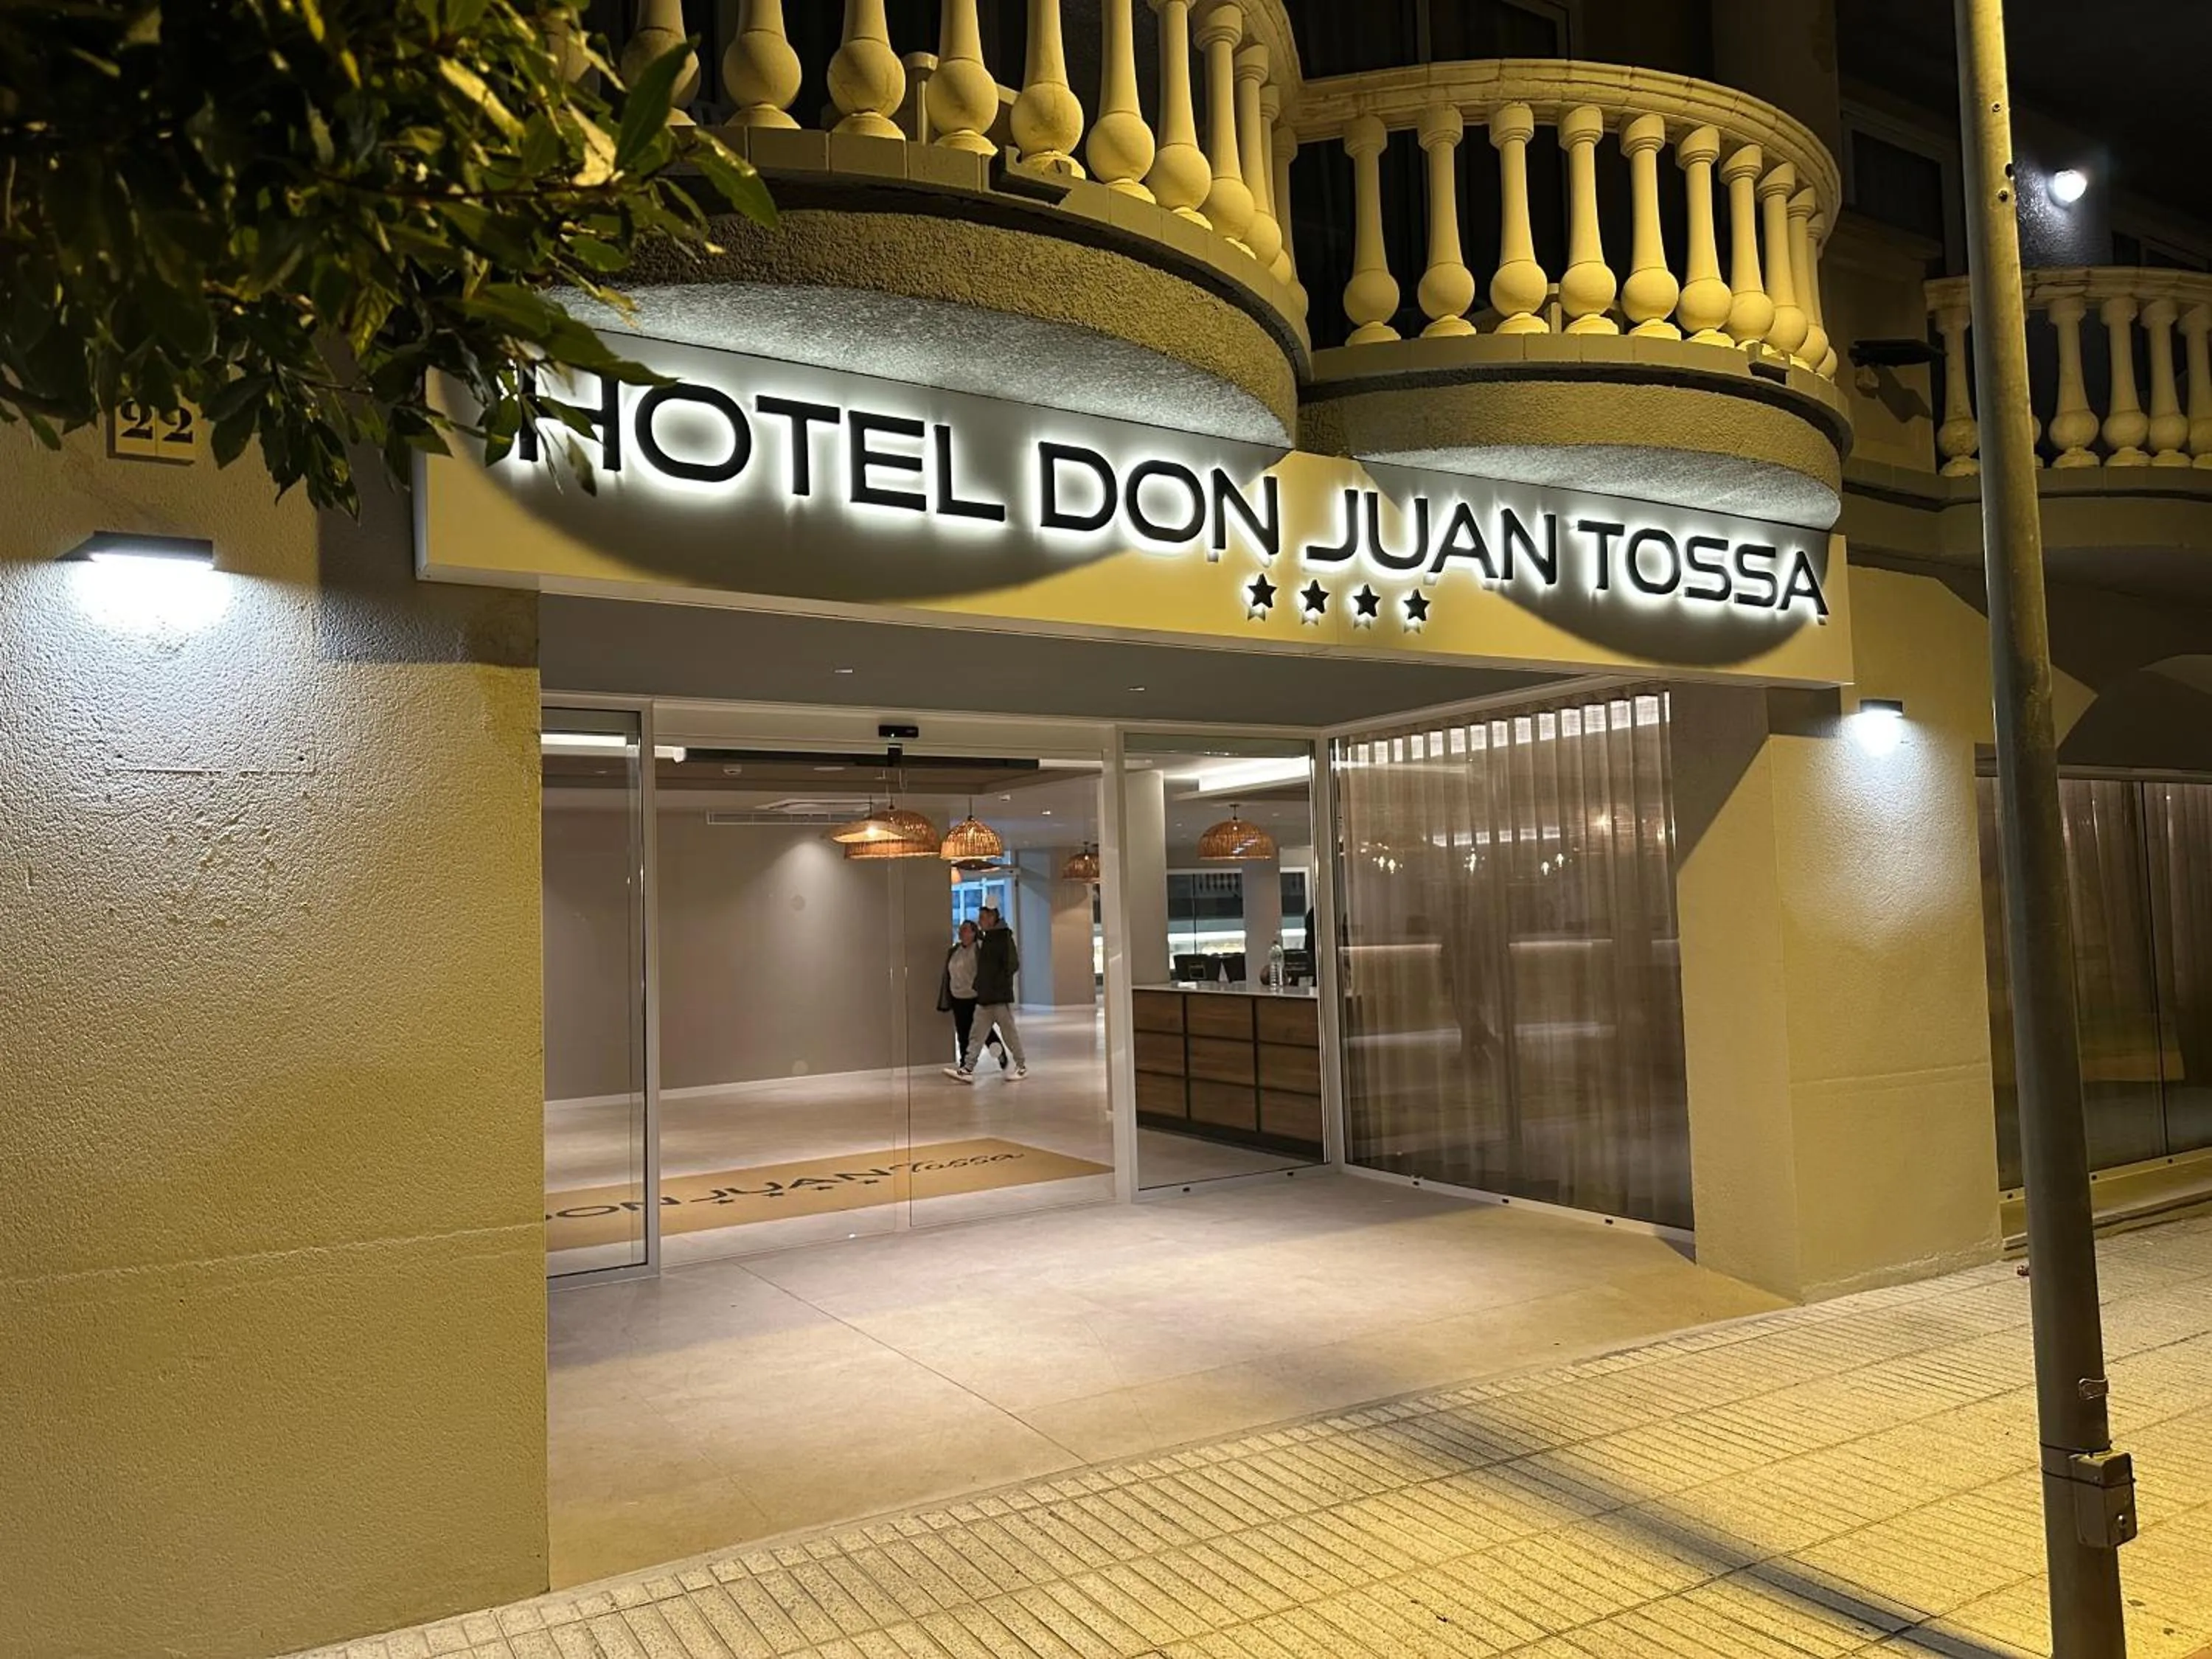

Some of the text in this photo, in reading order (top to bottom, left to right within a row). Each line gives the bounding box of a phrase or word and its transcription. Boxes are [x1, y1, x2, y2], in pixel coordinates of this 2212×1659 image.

[119, 399, 194, 444] 22
[518, 358, 1829, 616] HOTEL DON JUAN TOSSA
[545, 1153, 1025, 1220] ON JUAN Tossa
